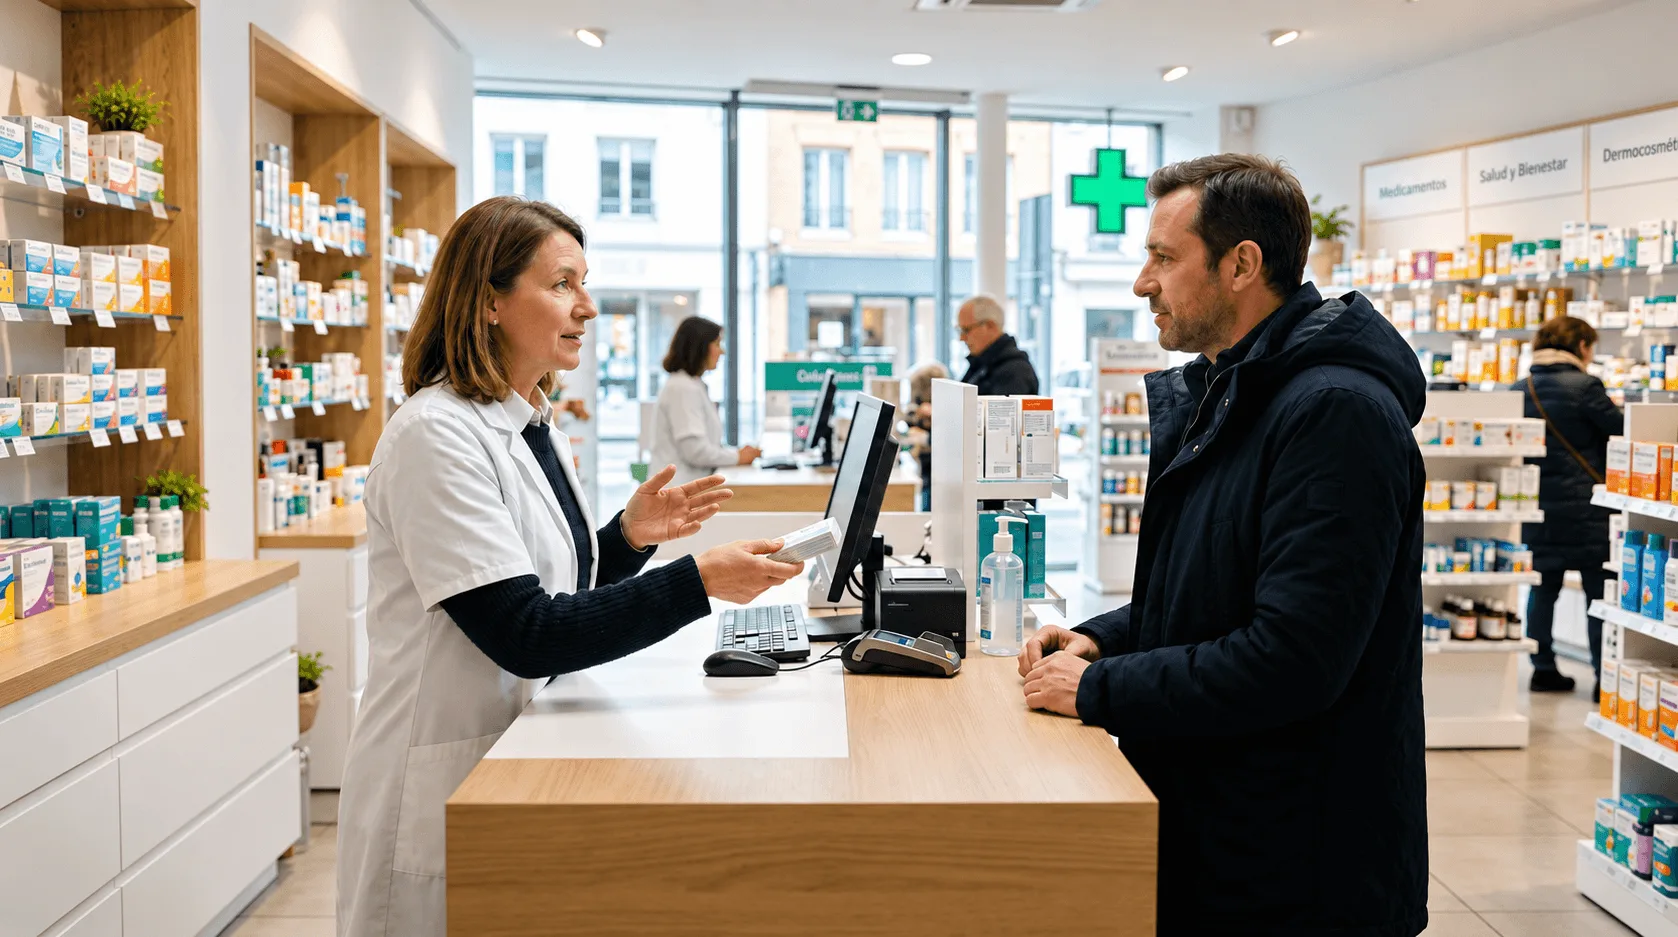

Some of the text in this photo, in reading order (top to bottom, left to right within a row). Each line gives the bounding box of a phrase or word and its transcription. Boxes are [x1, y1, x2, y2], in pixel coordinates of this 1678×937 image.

[1603, 136, 1678, 162] Dermocosmét
[1479, 158, 1568, 184] Salud y Bienestar
[1379, 179, 1447, 199] Medicamentos
